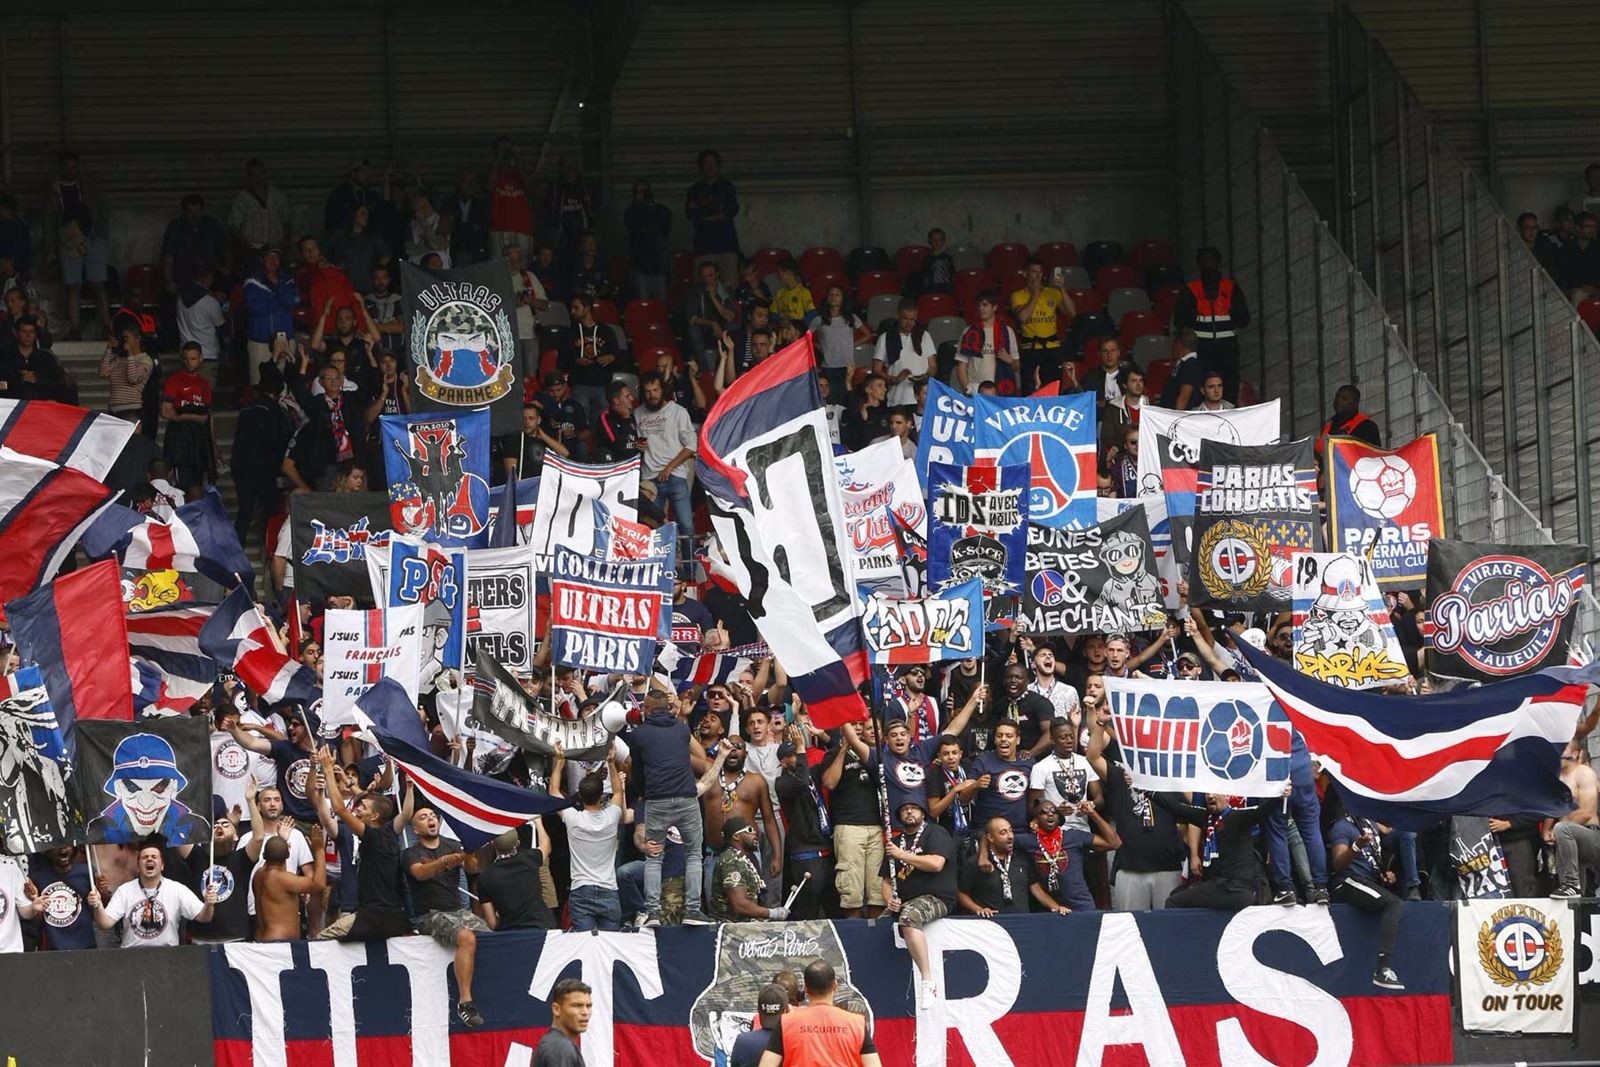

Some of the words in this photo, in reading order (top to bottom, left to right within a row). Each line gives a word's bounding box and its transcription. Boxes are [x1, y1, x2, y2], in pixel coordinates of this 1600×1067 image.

[418, 282, 501, 313] ULTRAS
[438, 386, 494, 402] PANAME
[985, 405, 1084, 432] VIRAGE
[1212, 464, 1296, 488] PARIAS
[939, 493, 985, 524] IDS
[989, 496, 1018, 510] AVEC
[1201, 488, 1313, 515] COHORTIS
[989, 511, 1019, 526] NOUS
[1345, 523, 1431, 545] PARIS
[557, 551, 664, 587] COLLECTIF
[859, 554, 893, 570] PARIS
[1297, 556, 1318, 590] 19
[1468, 564, 1525, 584] VIRAGE
[399, 558, 457, 609] PSG
[1062, 571, 1091, 604] &
[560, 588, 652, 629] ULTRAS
[1022, 602, 1168, 633] MECHANTS
[1435, 579, 1572, 649] Parias
[330, 632, 359, 642] J'SUIS
[399, 626, 415, 638] PAS
[345, 646, 402, 663] FRANÇAIS
[563, 631, 641, 671] PARIS
[1484, 640, 1546, 667] AUTEUIL
[329, 671, 359, 680] J'SUIS
[224, 901, 1354, 1067] ULTRAS
[1482, 995, 1509, 1012] ON
[1513, 994, 1563, 1012] TOUR
